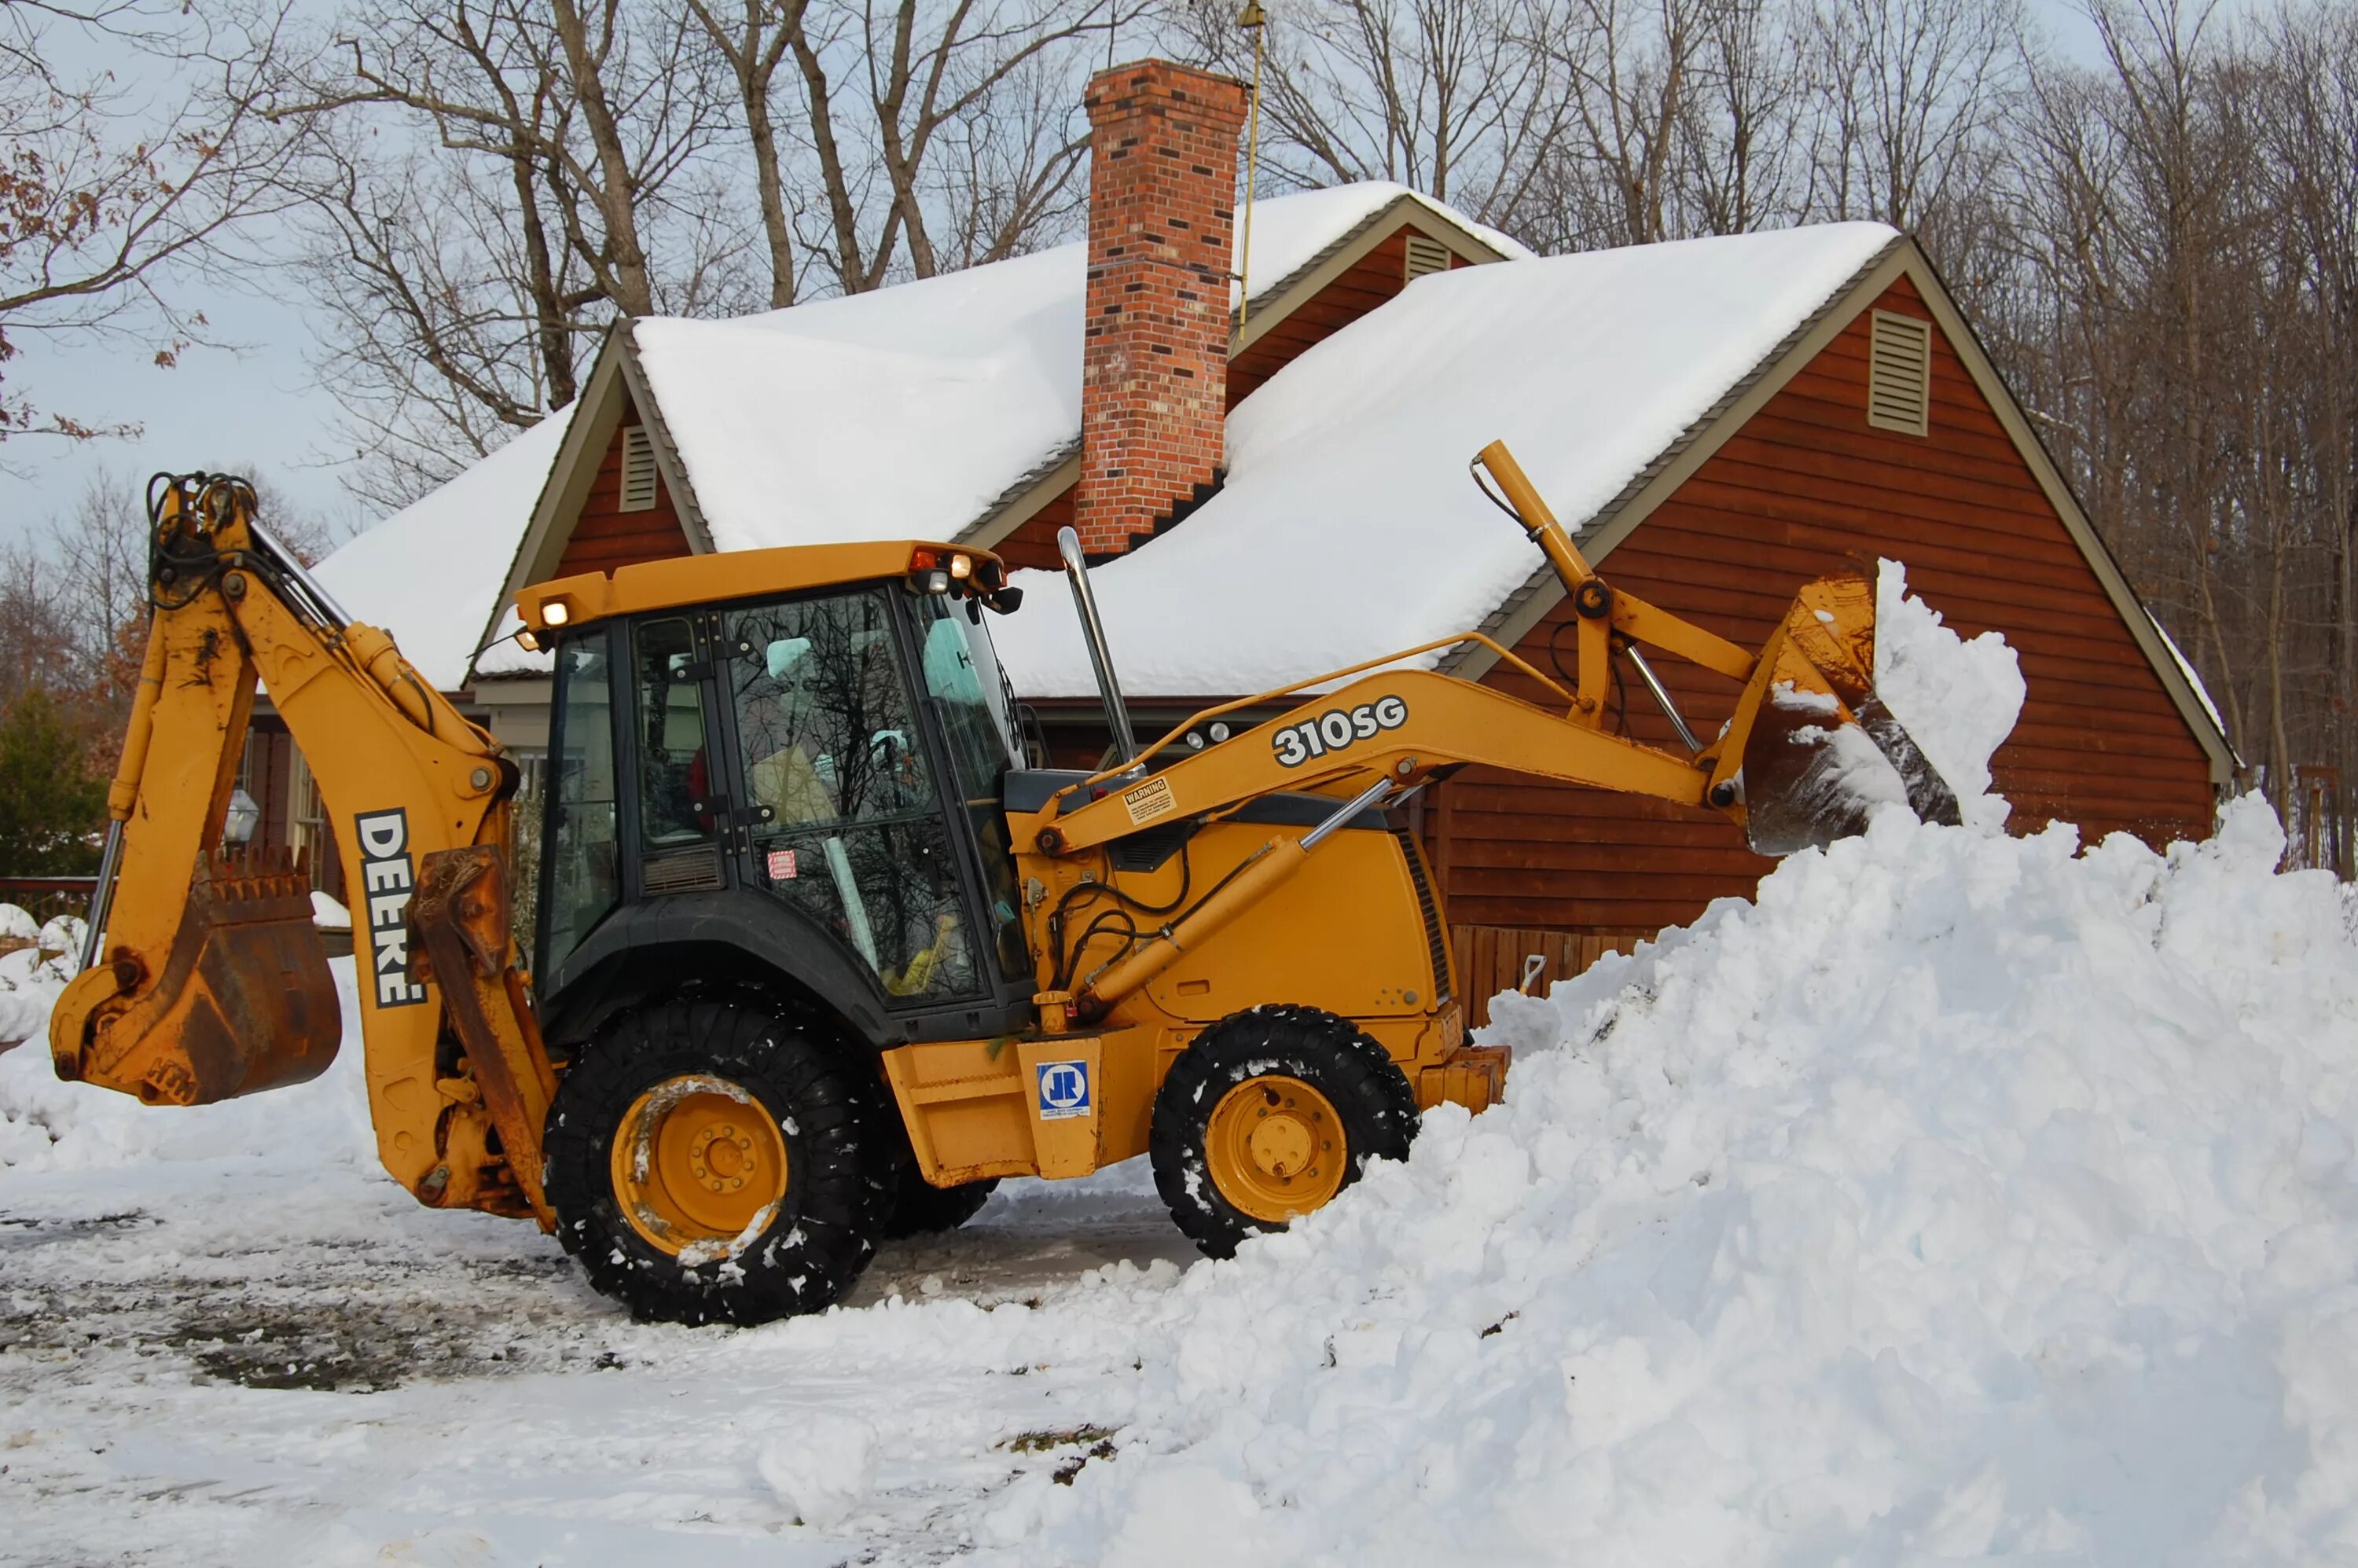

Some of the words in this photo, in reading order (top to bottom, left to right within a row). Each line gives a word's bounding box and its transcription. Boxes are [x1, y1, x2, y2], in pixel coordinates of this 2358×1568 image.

[1275, 697, 1405, 765] 310SG
[1125, 780, 1166, 804] WARNING
[358, 813, 423, 1004] DEERE
